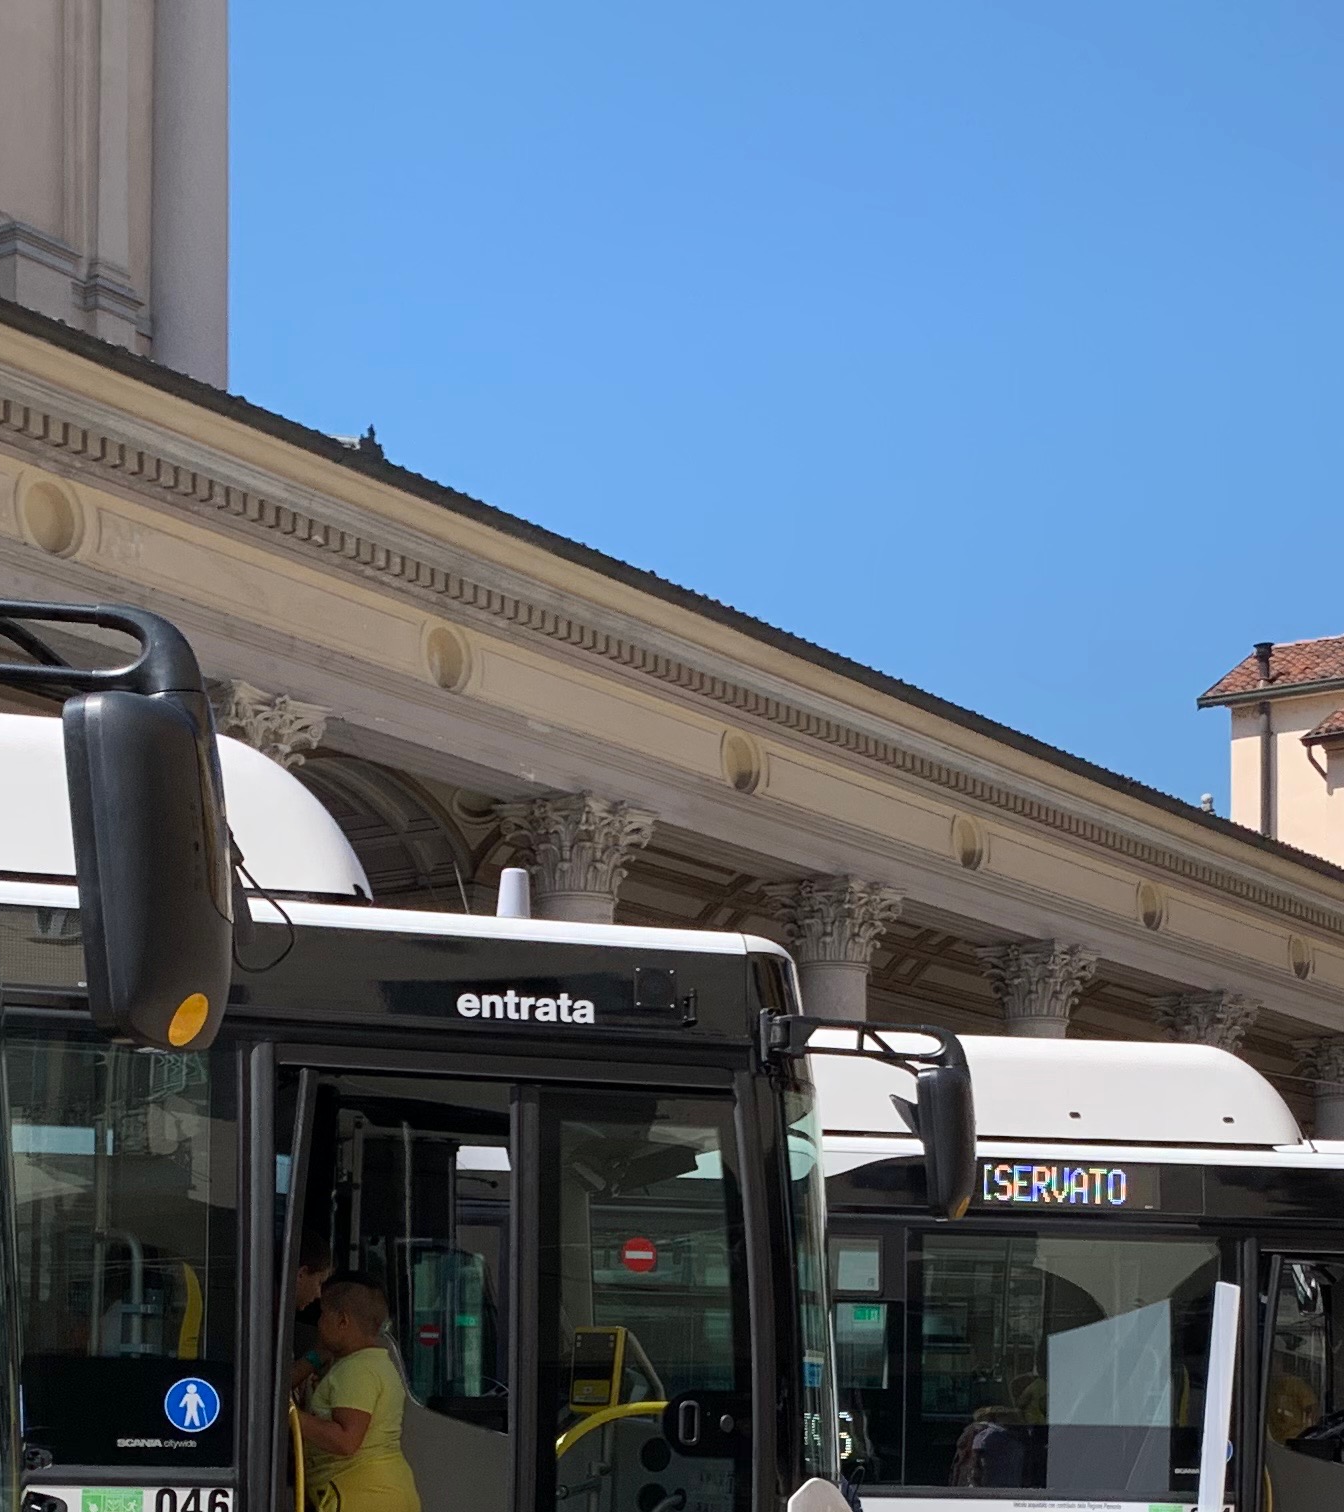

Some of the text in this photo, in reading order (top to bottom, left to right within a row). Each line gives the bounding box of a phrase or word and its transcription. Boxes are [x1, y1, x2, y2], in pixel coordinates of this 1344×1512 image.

[456, 990, 595, 1024] entrata
[983, 1164, 1126, 1205] ISERVATO
[116, 1438, 197, 1449] SCANIA citywide
